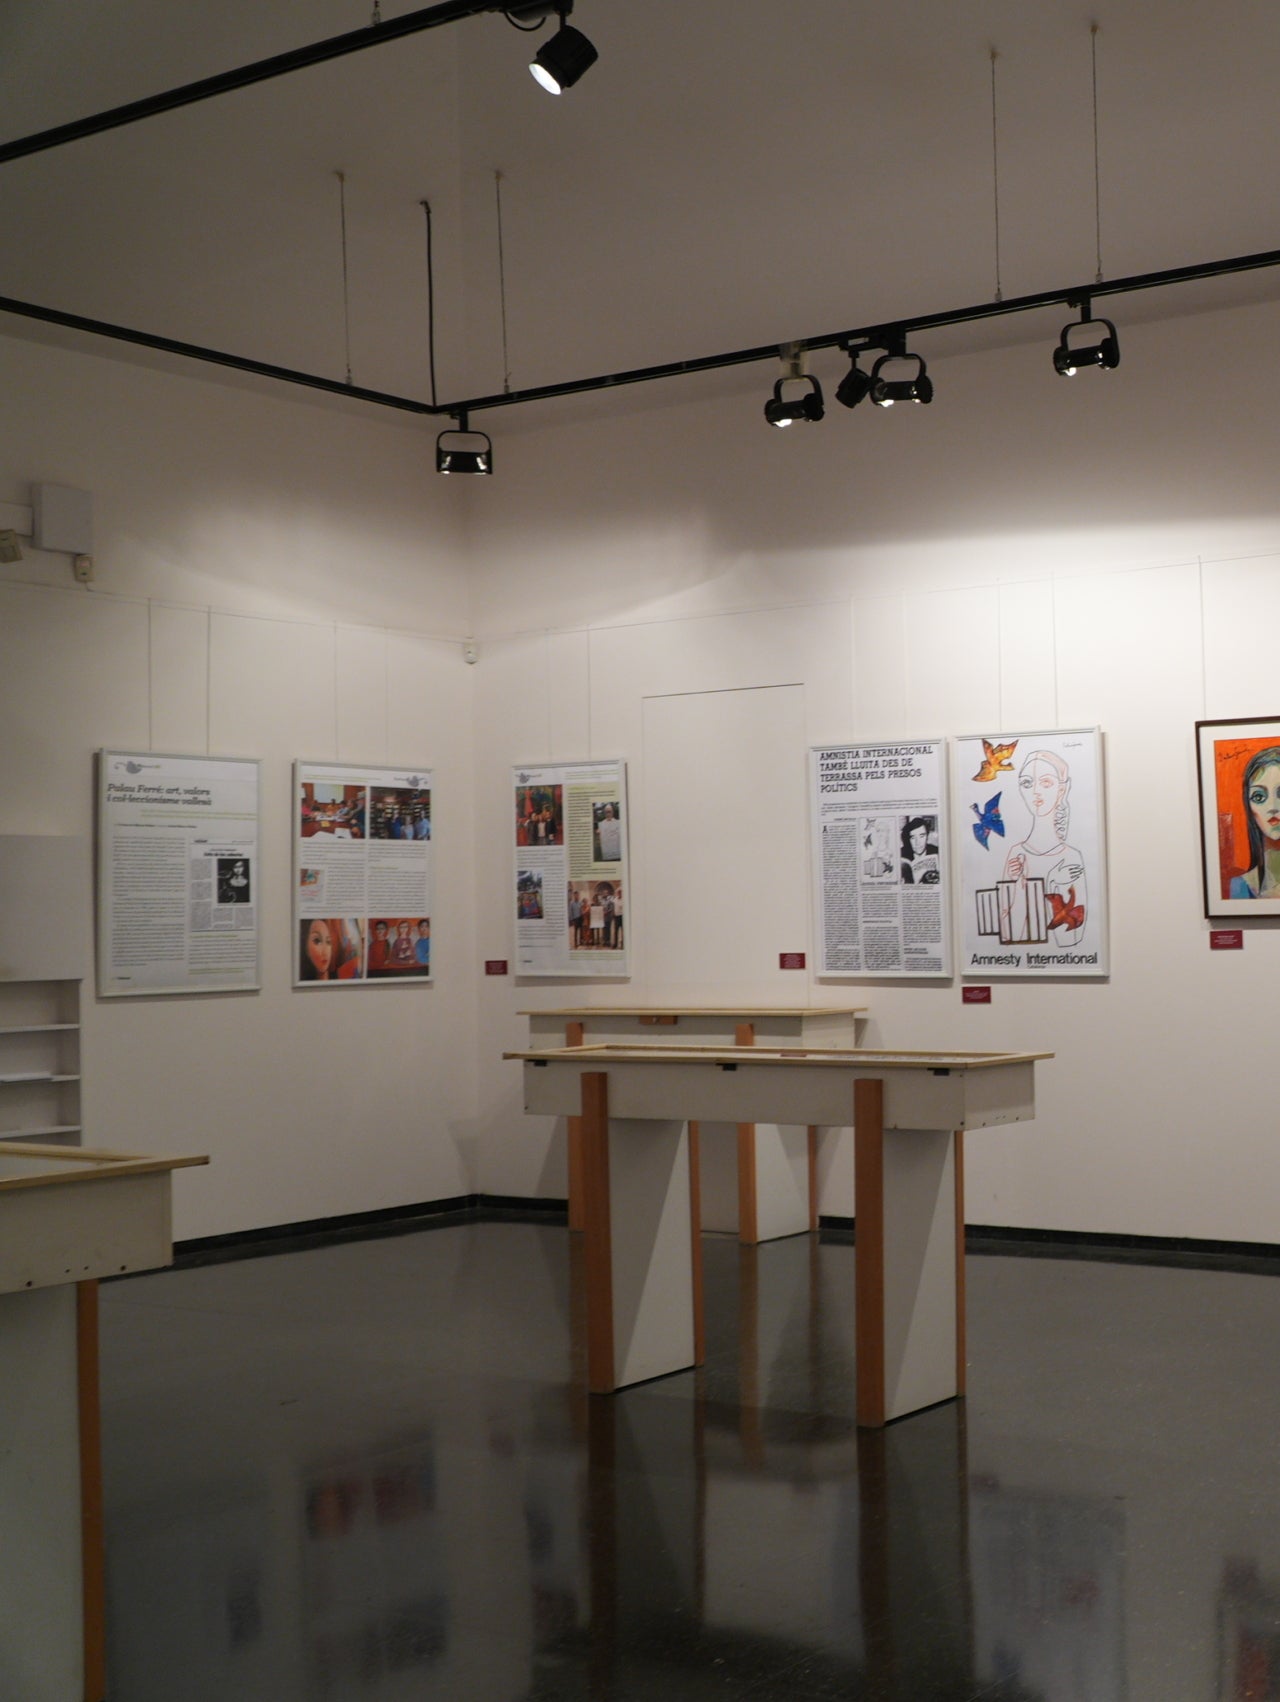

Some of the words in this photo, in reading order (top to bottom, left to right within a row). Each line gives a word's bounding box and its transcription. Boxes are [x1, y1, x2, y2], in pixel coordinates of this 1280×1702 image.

[820, 750, 861, 761] AMNISTIA
[862, 745, 934, 759] INTERNACIONAL
[820, 760, 848, 772] TAMBÉ
[850, 760, 880, 771] LLUITA
[882, 759, 899, 769] DES
[901, 758, 913, 768] DE
[820, 772, 863, 783] TERRASSA
[865, 771, 885, 781] PELS
[888, 768, 922, 779] PRESOS
[107, 783, 135, 793] Palau
[183, 786, 210, 796] valors
[820, 782, 858, 794] POLÍTICS
[970, 953, 1022, 967] Amnesty
[1026, 952, 1098, 965] International
